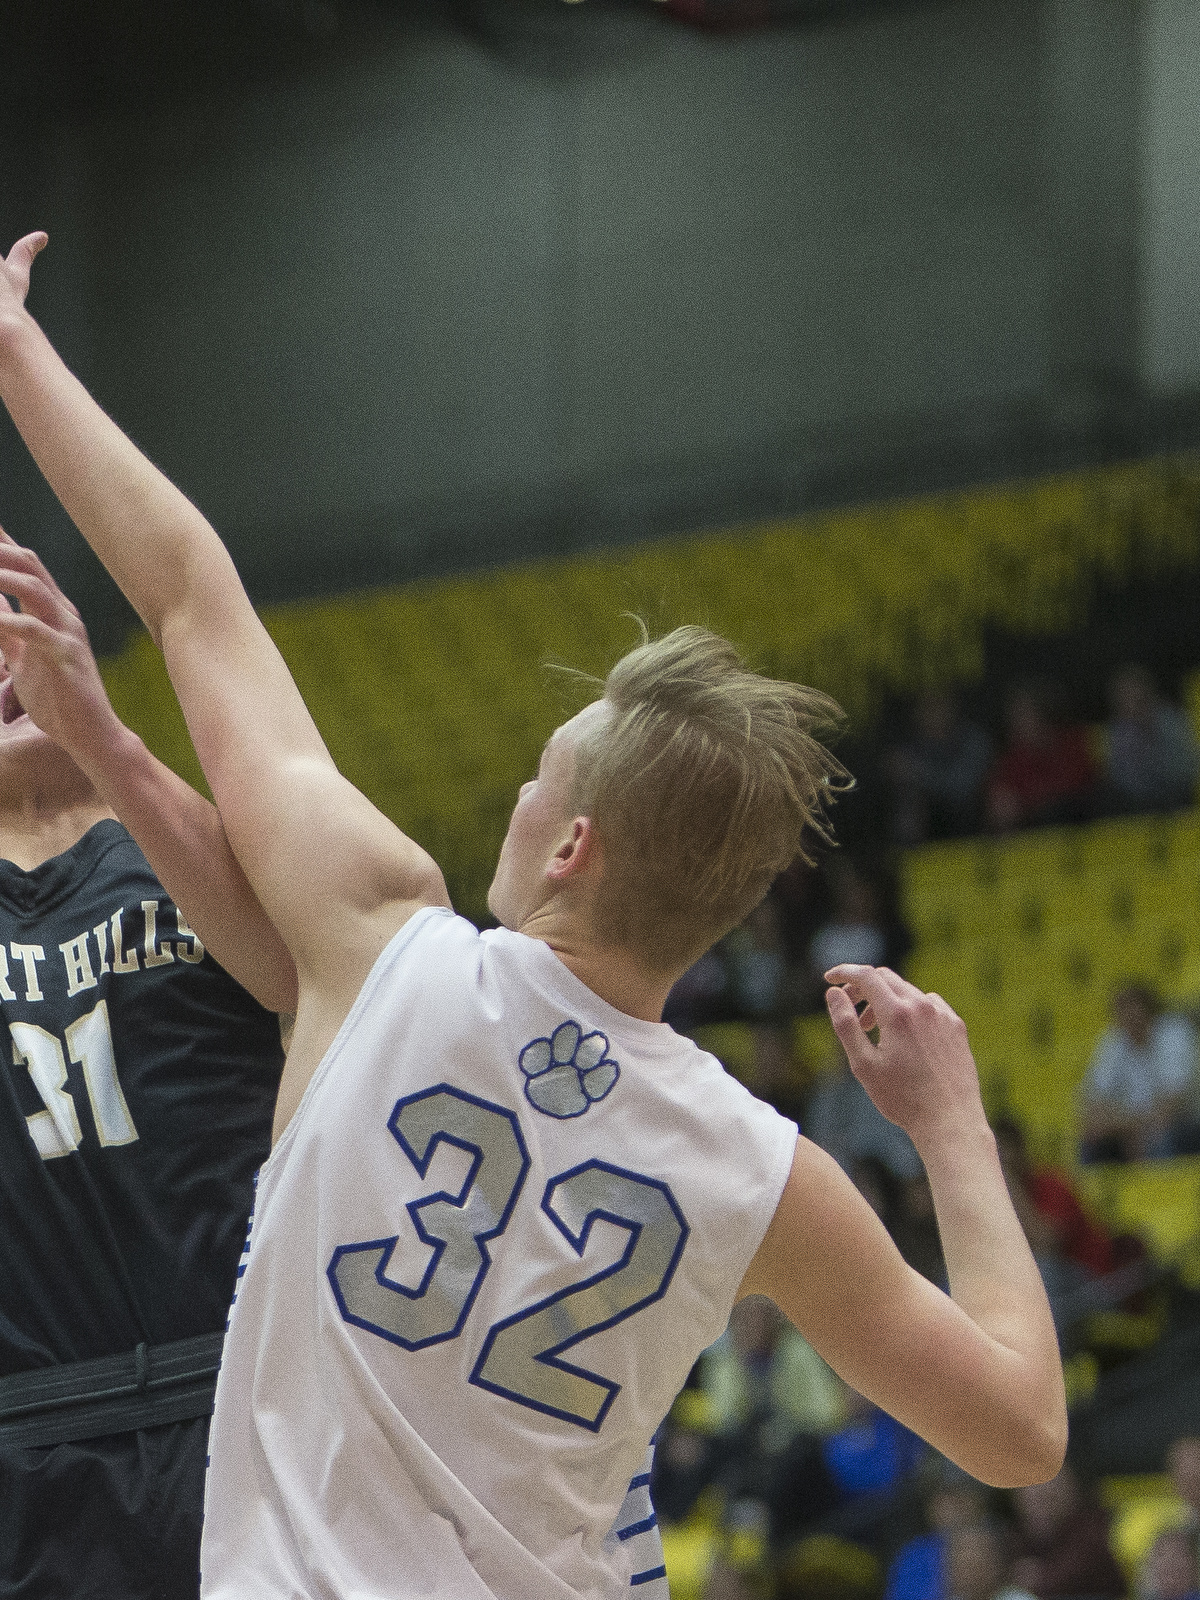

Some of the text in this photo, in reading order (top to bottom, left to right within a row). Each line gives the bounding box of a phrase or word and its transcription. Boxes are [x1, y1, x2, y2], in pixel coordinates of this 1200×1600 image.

[59, 900, 205, 998] HILLS
[8, 1000, 140, 1161] 31
[327, 1083, 690, 1433] 32
